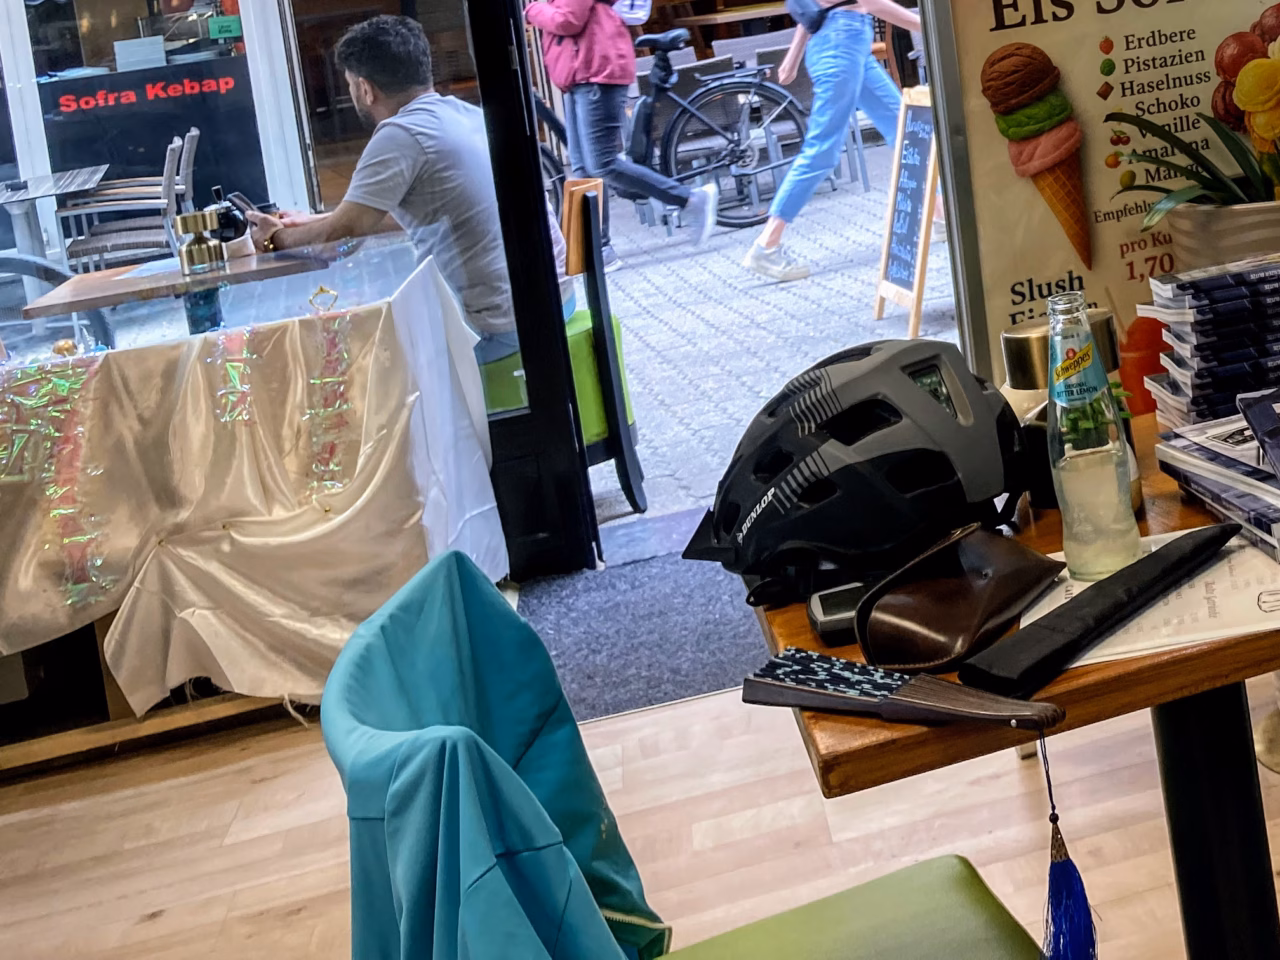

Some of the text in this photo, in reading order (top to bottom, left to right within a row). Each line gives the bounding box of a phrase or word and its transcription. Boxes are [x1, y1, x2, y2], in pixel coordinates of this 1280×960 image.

[1123, 28, 1197, 51] Erdbere
[1122, 48, 1206, 74] Pistazien
[59, 76, 235, 113] Sofra Kebap
[1119, 69, 1211, 98] Haselnuss
[1135, 93, 1201, 118] Schoko
[1137, 115, 1202, 139] Vnille
[1128, 137, 1211, 164] Amarna
[1093, 200, 1155, 224] Empfehlu
[1119, 239, 1148, 258] pro
[1125, 252, 1176, 283] 1,70
[1010, 270, 1085, 306] Slush
[1055, 350, 1091, 381] Schweppes
[1076, 386, 1098, 396] LEMON
[742, 487, 775, 536] DUNLOP
